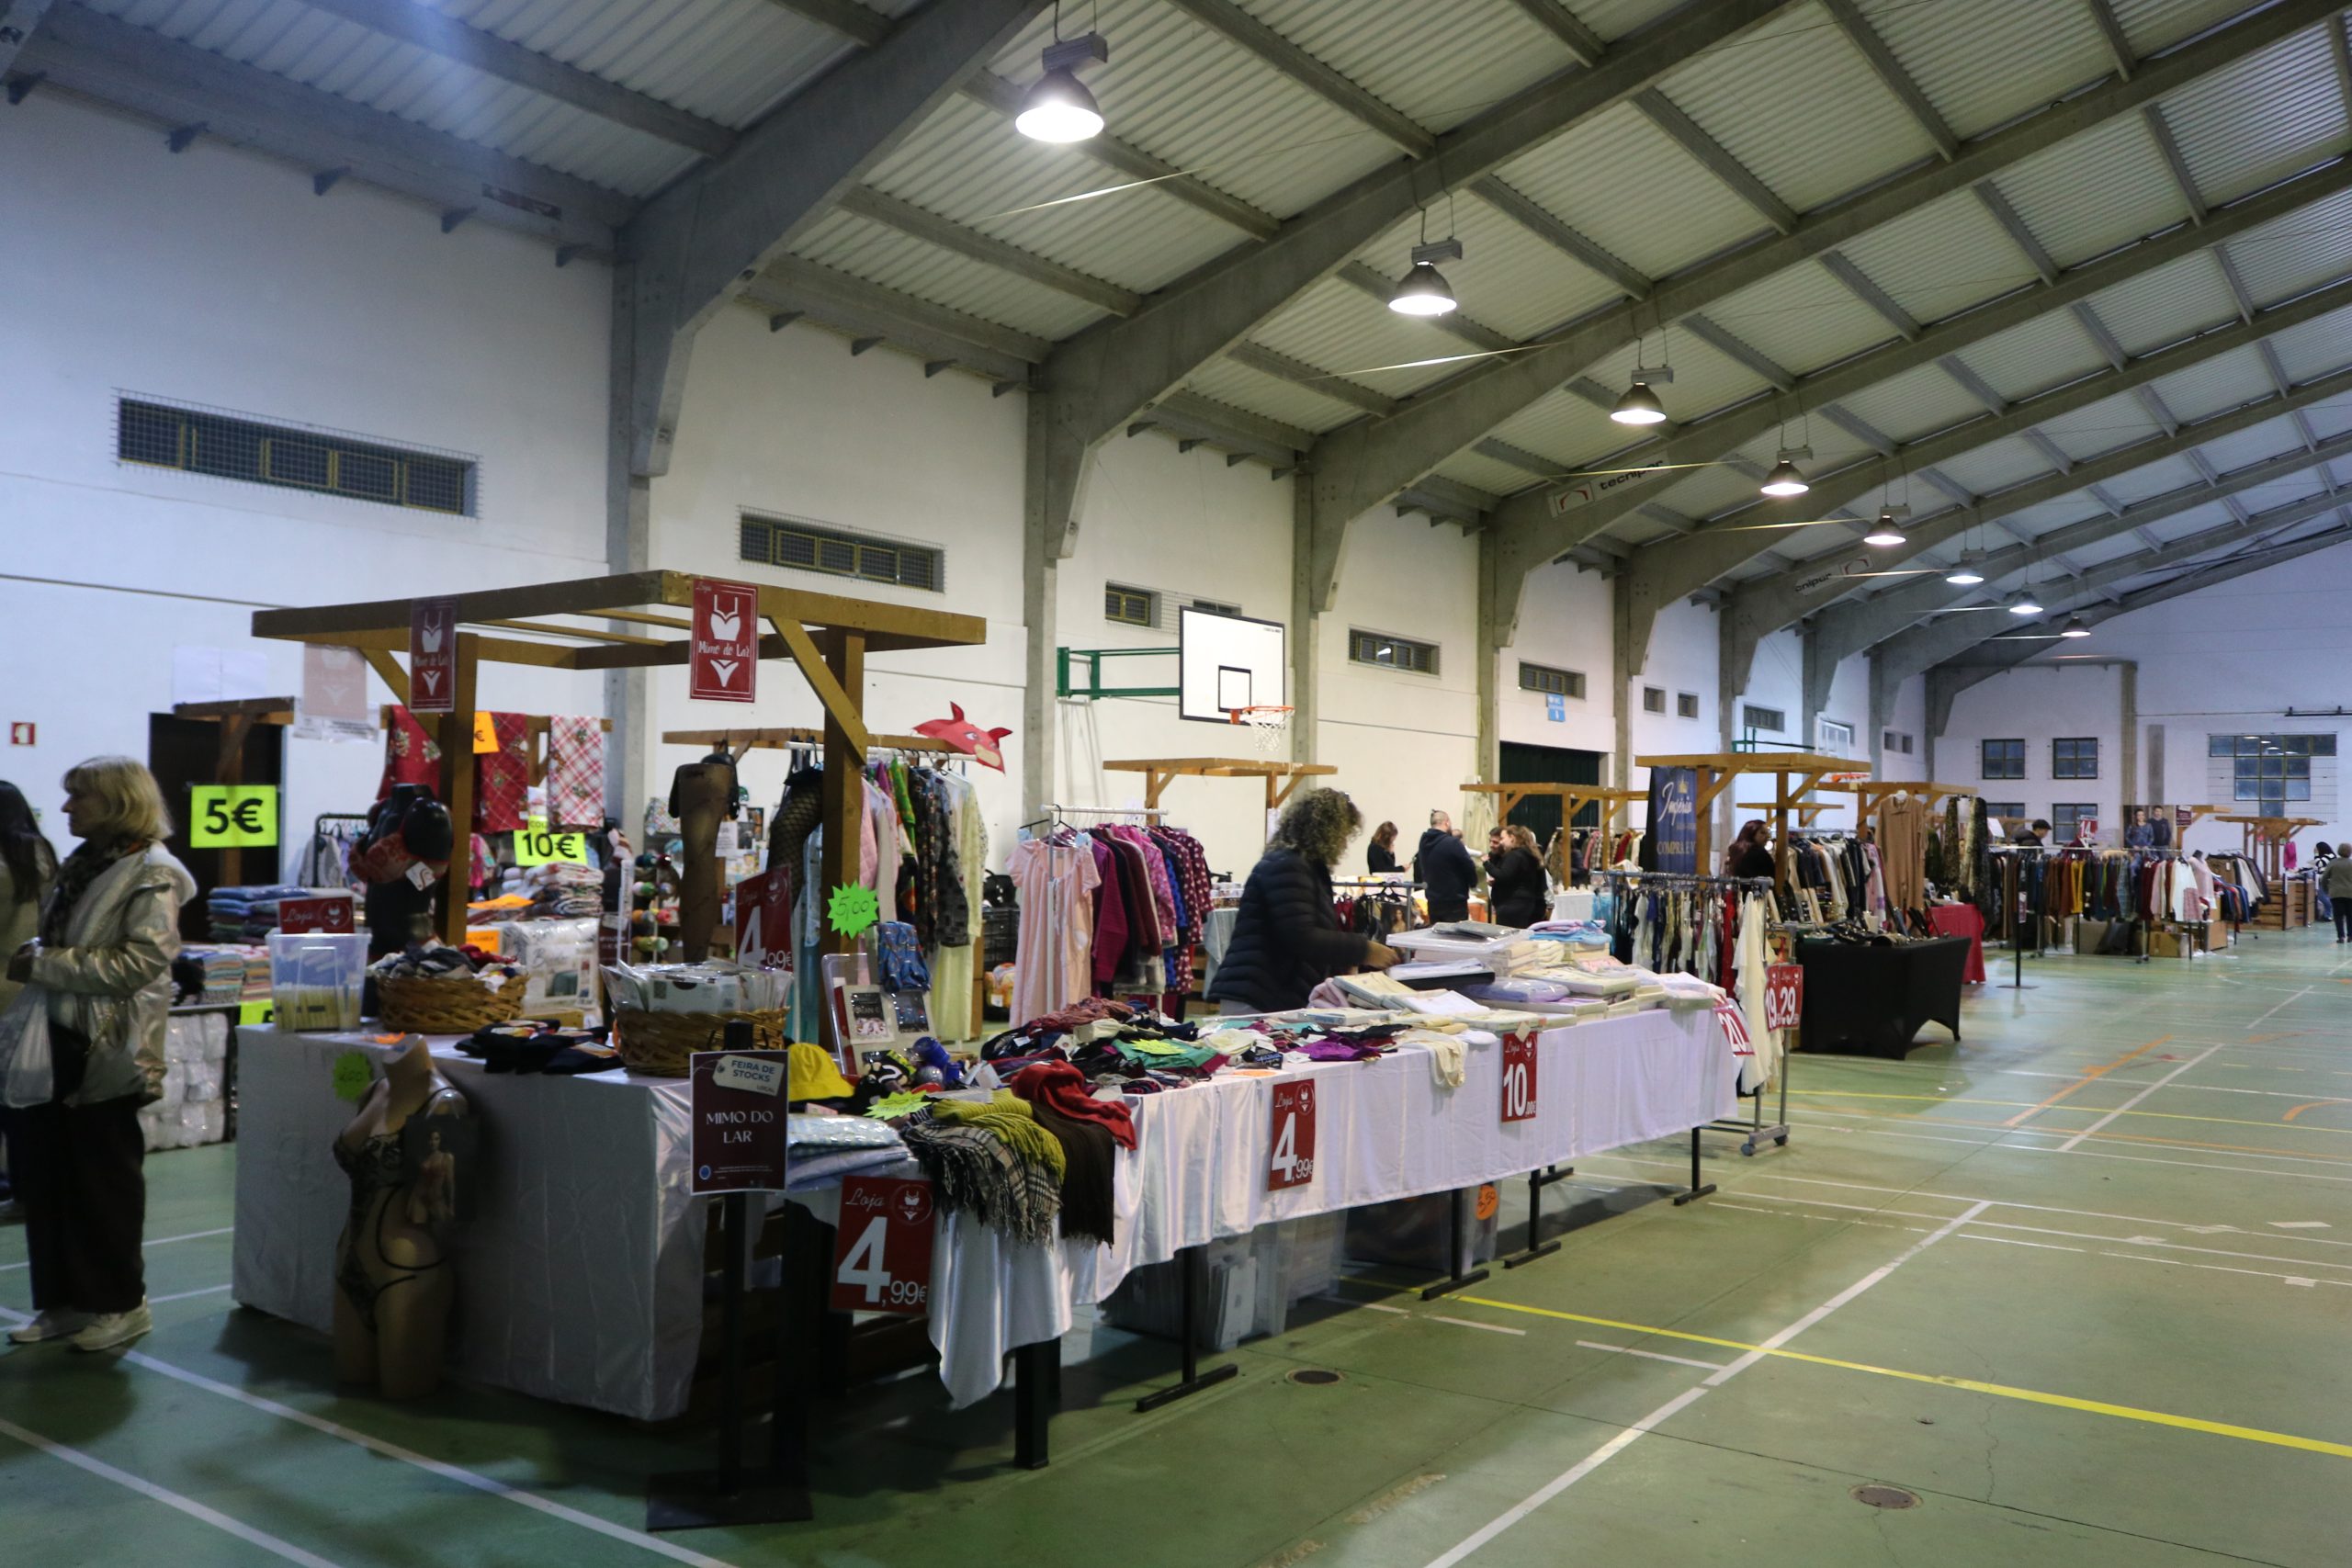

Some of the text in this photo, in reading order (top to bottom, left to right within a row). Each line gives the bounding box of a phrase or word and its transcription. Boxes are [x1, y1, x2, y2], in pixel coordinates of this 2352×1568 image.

[204, 797, 264, 835] 5€
[522, 832, 578, 858] 10€
[835, 896, 870, 921] 5,00
[730, 1059, 775, 1075] FEIRA DE
[732, 1069, 771, 1083] STOCKS
[1274, 1092, 1295, 1111] Loja
[706, 1110, 774, 1125] MIMO DO
[723, 1131, 752, 1144] LAR
[845, 1187, 886, 1213] Loja
